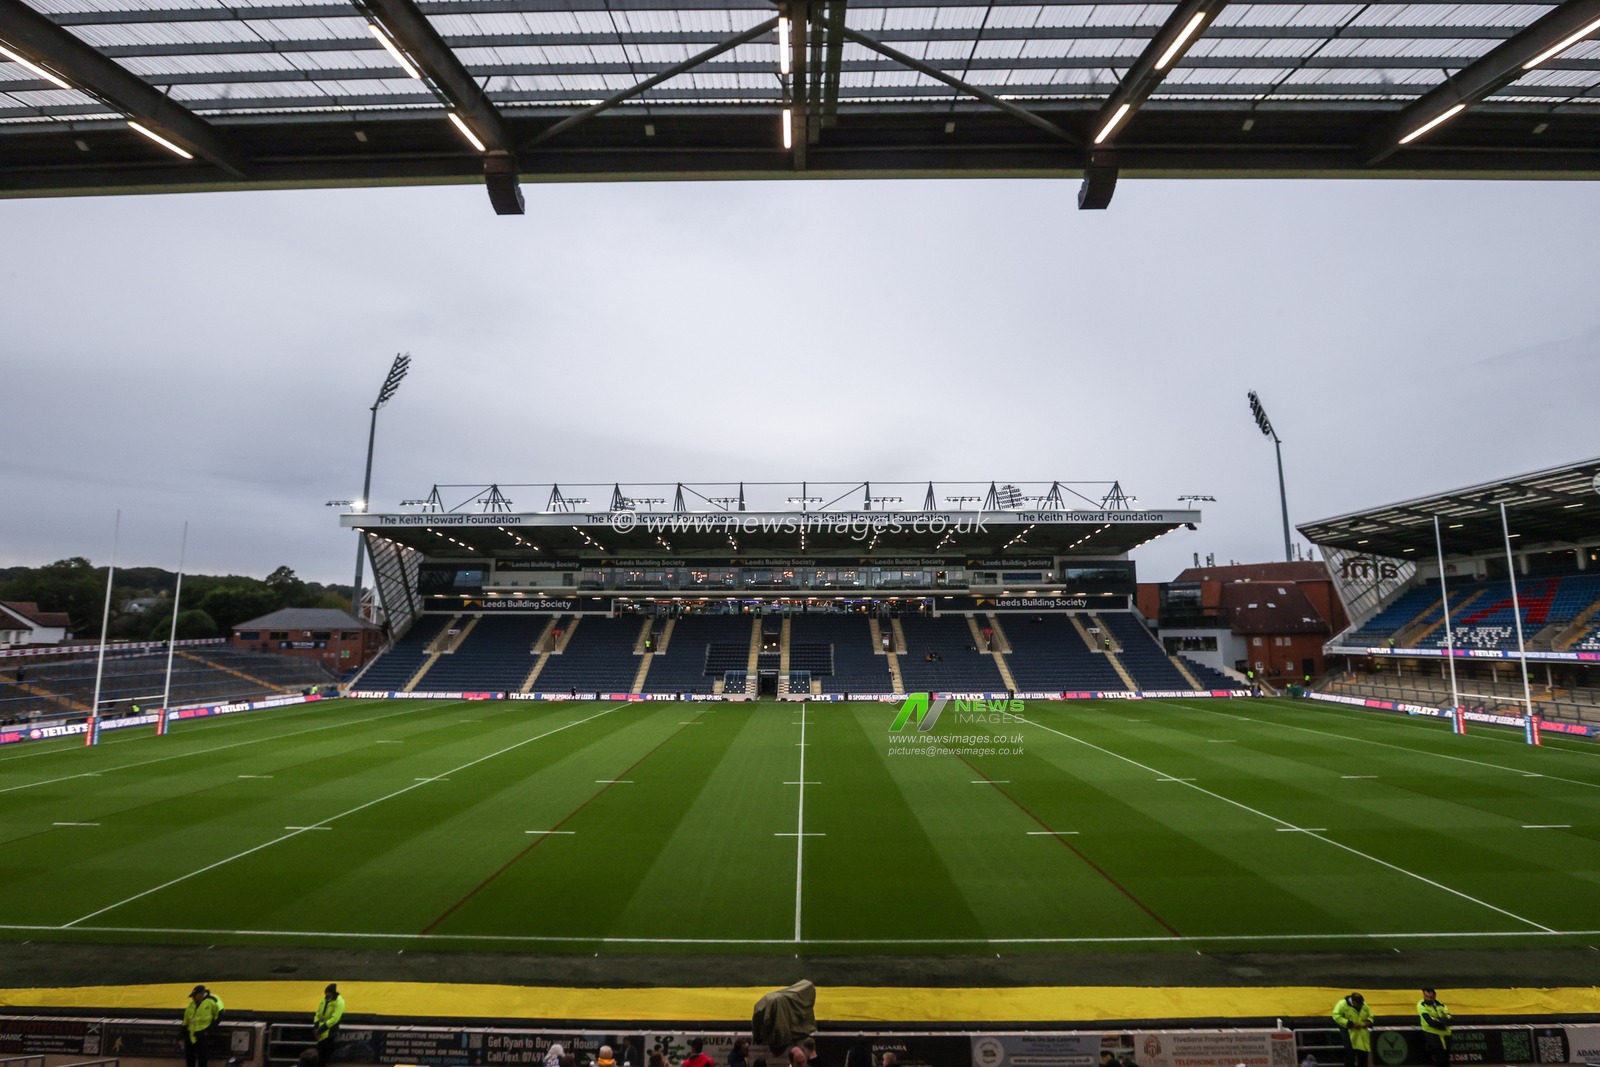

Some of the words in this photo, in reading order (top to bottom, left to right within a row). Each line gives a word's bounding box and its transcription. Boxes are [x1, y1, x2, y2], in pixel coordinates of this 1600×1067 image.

[378, 516, 396, 526] The
[399, 515, 424, 526] Keith
[426, 515, 463, 526] Howard
[466, 514, 521, 525] Foundation
[585, 514, 602, 524] The
[677, 514, 733, 524] Foundation
[801, 514, 818, 523] The
[822, 514, 847, 523] Keith
[851, 514, 890, 523] Howard
[893, 514, 950, 523] Foundation
[1016, 513, 1034, 523] The
[1038, 513, 1063, 523] Keith
[1066, 513, 1104, 523] Howard
[1107, 513, 1163, 523] Foundation
[511, 561, 529, 570] Leeds
[530, 561, 555, 570] Building
[556, 561, 580, 570] Society
[615, 559, 634, 568] Leeds
[635, 559, 660, 568] Building
[661, 559, 686, 568] Society
[982, 559, 1001, 568] Leeds
[1002, 559, 1026, 568] Building
[1027, 559, 1052, 568] Society
[482, 599, 506, 610] Leeds
[507, 599, 539, 610] Building
[540, 599, 571, 610] Society
[995, 598, 1020, 609] Leeds
[1021, 598, 1054, 609] Building
[1055, 598, 1087, 609] Society
[357, 691, 389, 699] TETLEY'S
[1404, 704, 1440, 715] TETLEY'S
[1465, 1032, 1485, 1041] AND
[488, 1036, 501, 1048] Get
[503, 1037, 523, 1051] Ryan
[525, 1037, 534, 1049] to
[535, 1037, 551, 1051] Buy
[573, 1038, 599, 1050] House
